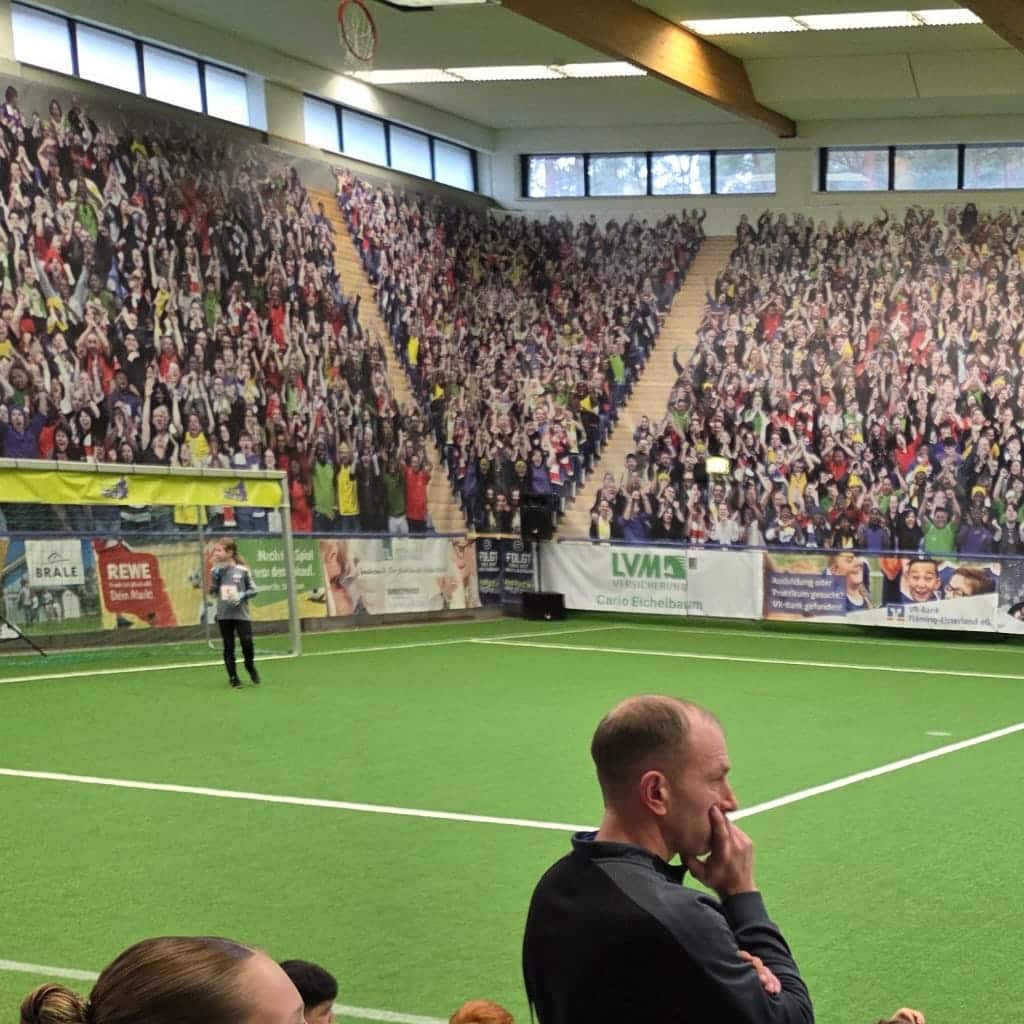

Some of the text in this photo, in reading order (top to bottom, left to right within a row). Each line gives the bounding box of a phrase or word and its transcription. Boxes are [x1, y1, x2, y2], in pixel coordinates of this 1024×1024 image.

[35, 565, 79, 579] BRALE
[107, 562, 152, 580] REWE
[612, 552, 661, 578] LVM
[597, 594, 704, 610] Carlo Eichelbaum
